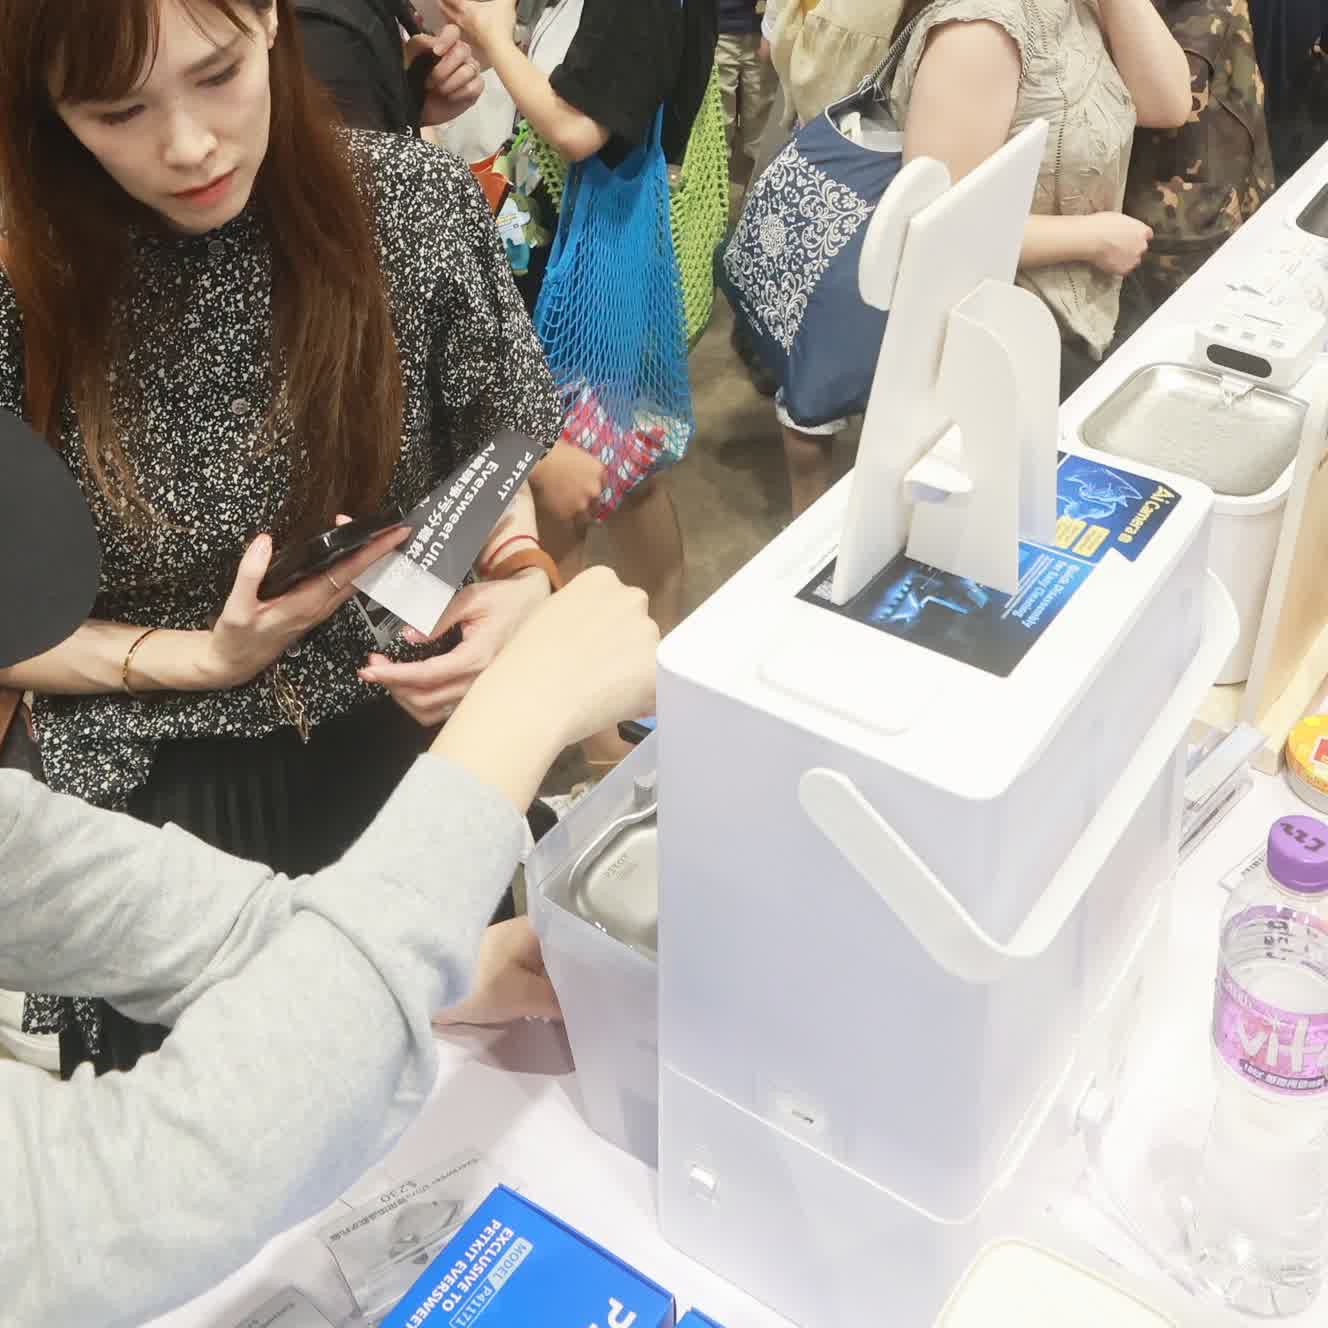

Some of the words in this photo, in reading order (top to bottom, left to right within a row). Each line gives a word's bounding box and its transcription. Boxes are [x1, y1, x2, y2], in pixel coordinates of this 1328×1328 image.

[497, 451, 534, 502] PETKIT
[438, 460, 500, 541] Eversweet
[457, 1226, 515, 1293] EXCLUSIVE
[462, 1219, 503, 1263] PETKIT
[492, 1241, 531, 1282] MODEL
[440, 1290, 468, 1313] TO
